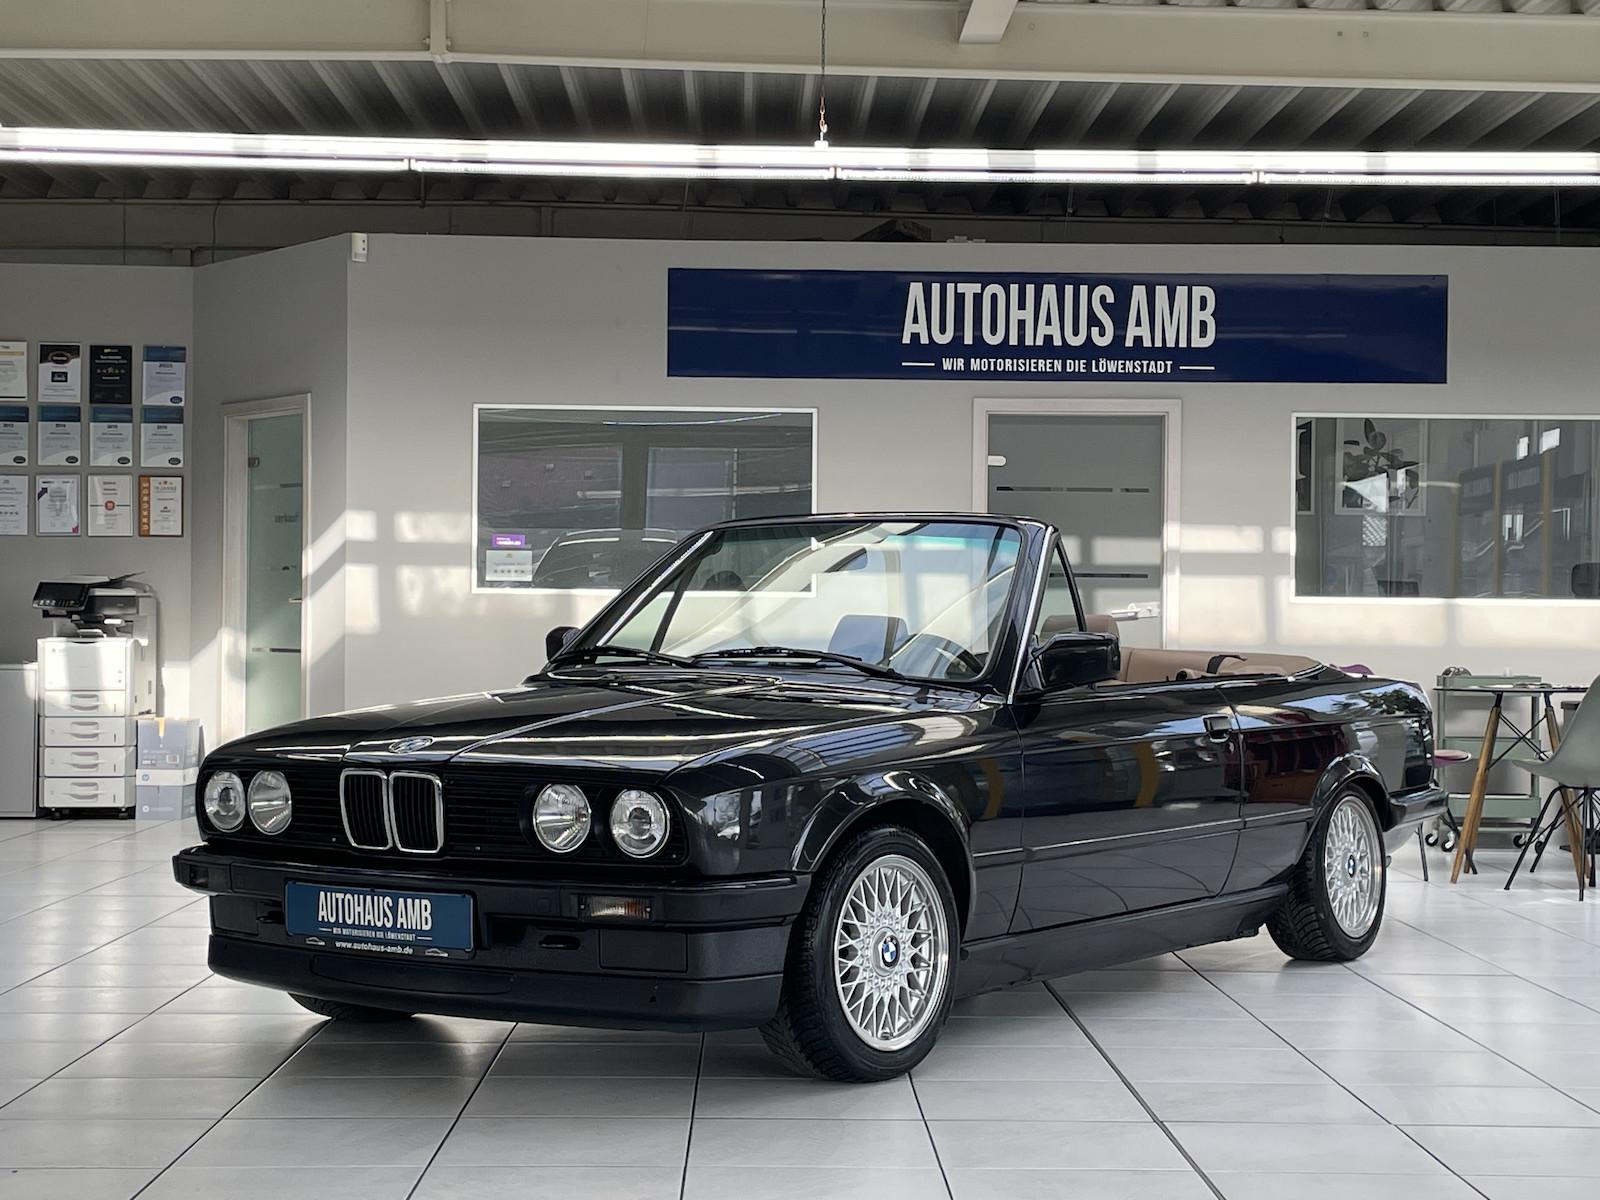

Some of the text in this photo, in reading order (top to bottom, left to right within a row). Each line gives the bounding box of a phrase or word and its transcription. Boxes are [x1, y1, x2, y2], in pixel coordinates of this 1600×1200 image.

[902, 282, 1216, 348] AUTOHAUS AMB
[942, 358, 1172, 374] WIR MOTORISIEREN DIE LÖWENSTADT
[318, 891, 433, 930] AUTOHAUS AMB
[335, 941, 414, 954] www.autohaus-amb.de
